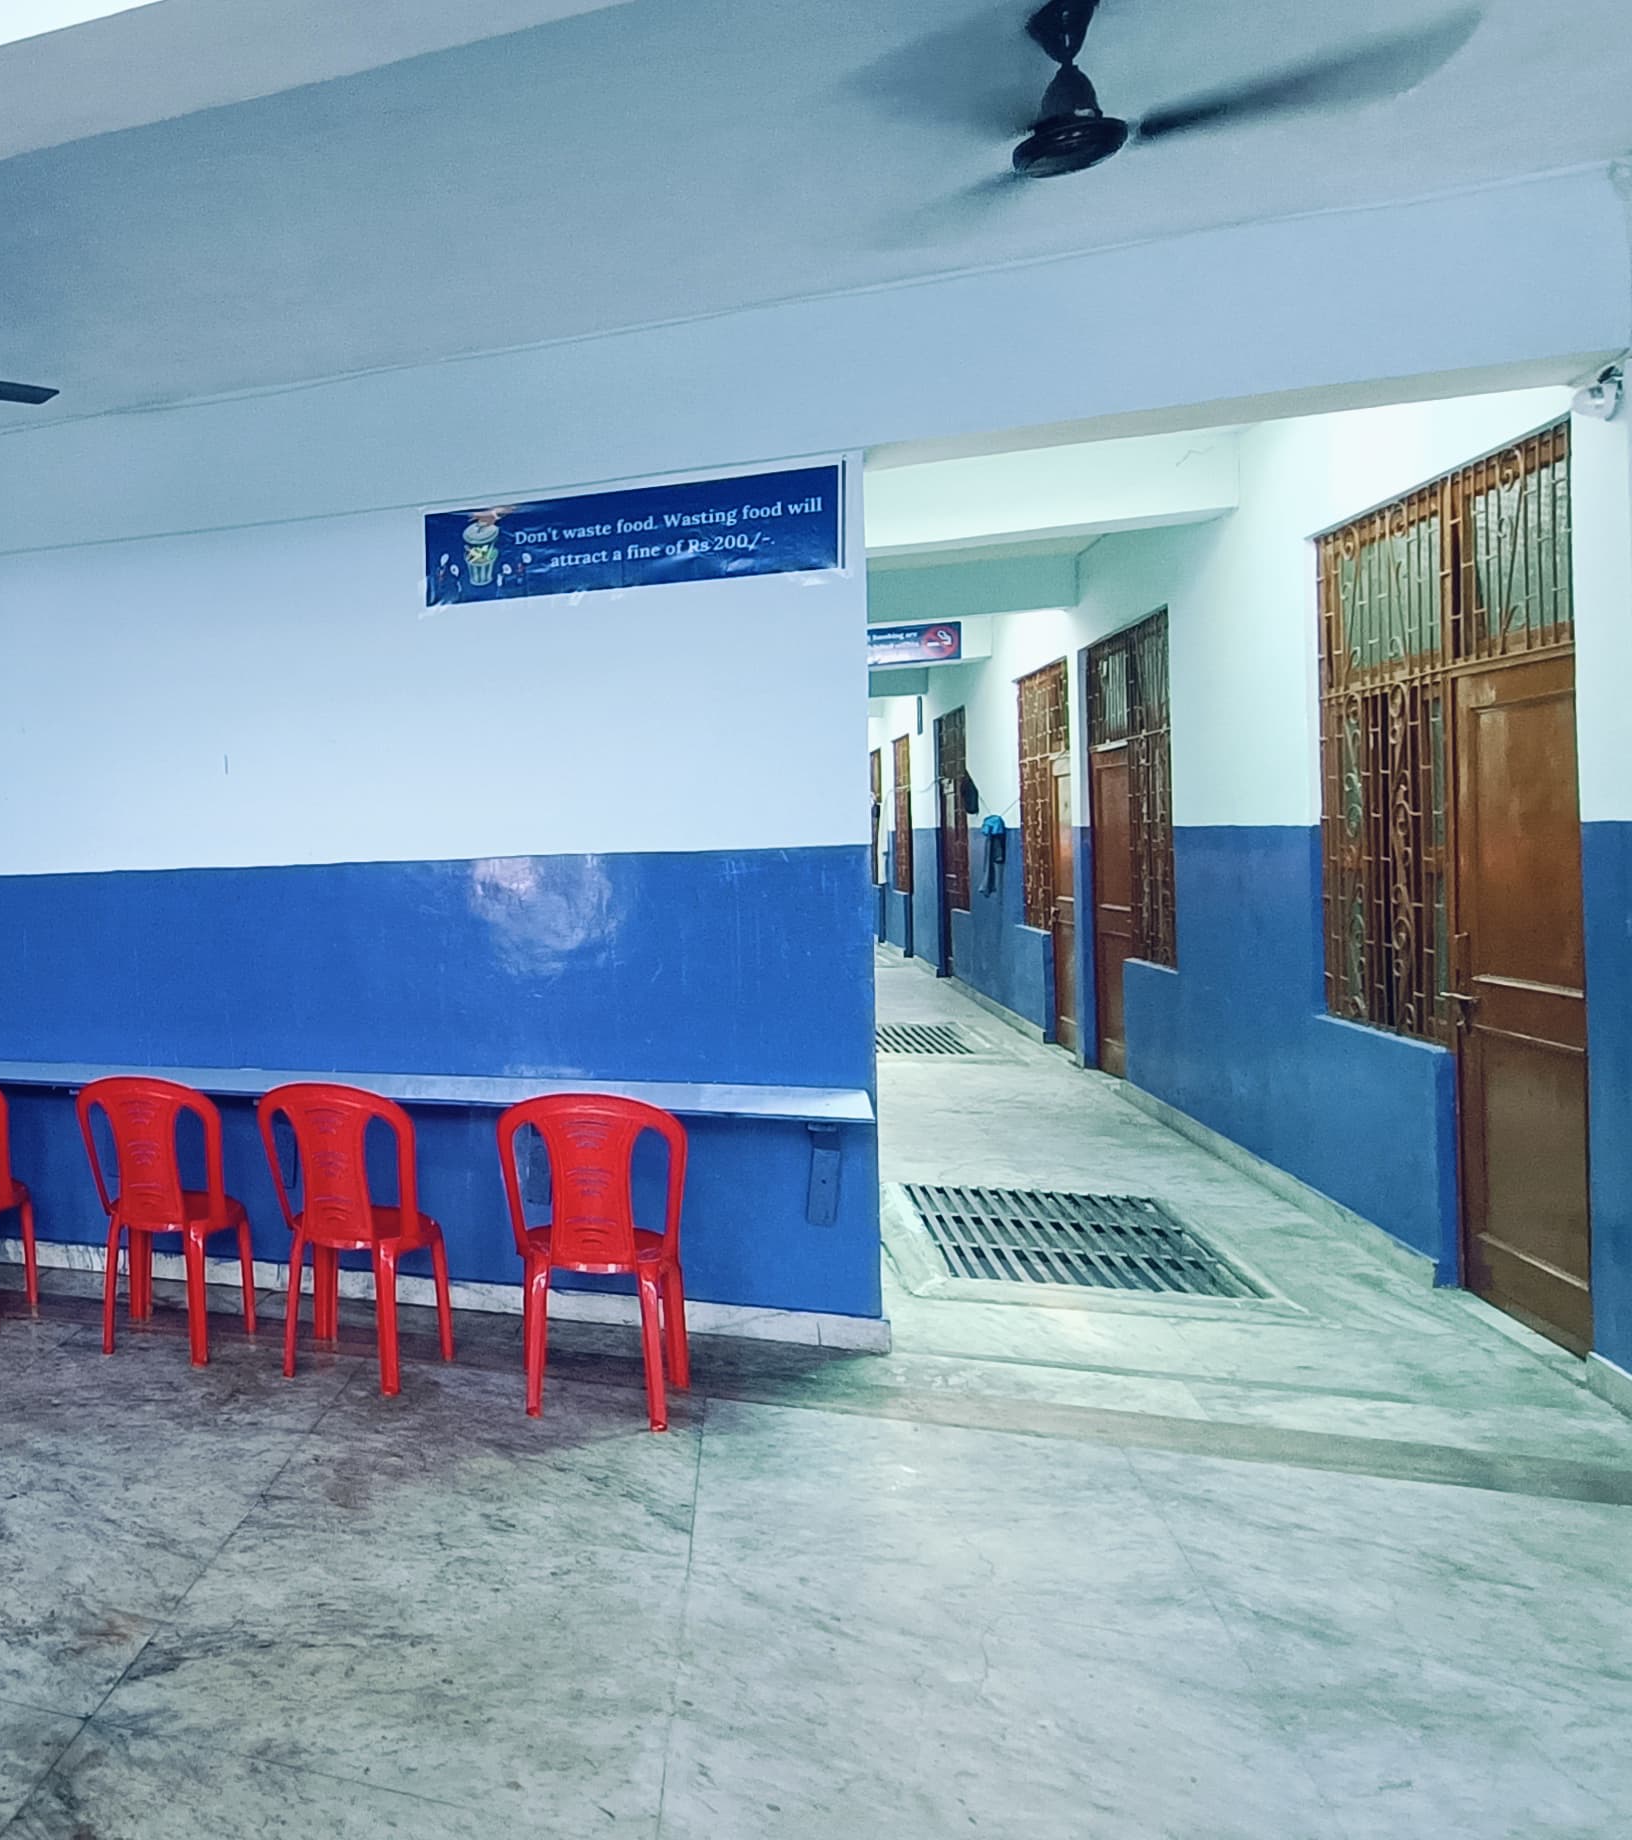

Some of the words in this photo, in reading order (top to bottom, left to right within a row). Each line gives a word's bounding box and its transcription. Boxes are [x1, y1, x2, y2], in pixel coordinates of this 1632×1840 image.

[515, 527, 560, 545] Don't
[563, 524, 612, 539] waste
[616, 515, 658, 533] food.
[663, 508, 737, 528] Wasting
[742, 501, 783, 520] food
[788, 496, 823, 515] will
[551, 550, 608, 568] attract
[612, 550, 622, 561] a
[627, 544, 662, 560] fine
[665, 540, 685, 556] of
[688, 538, 709, 553] Rs
